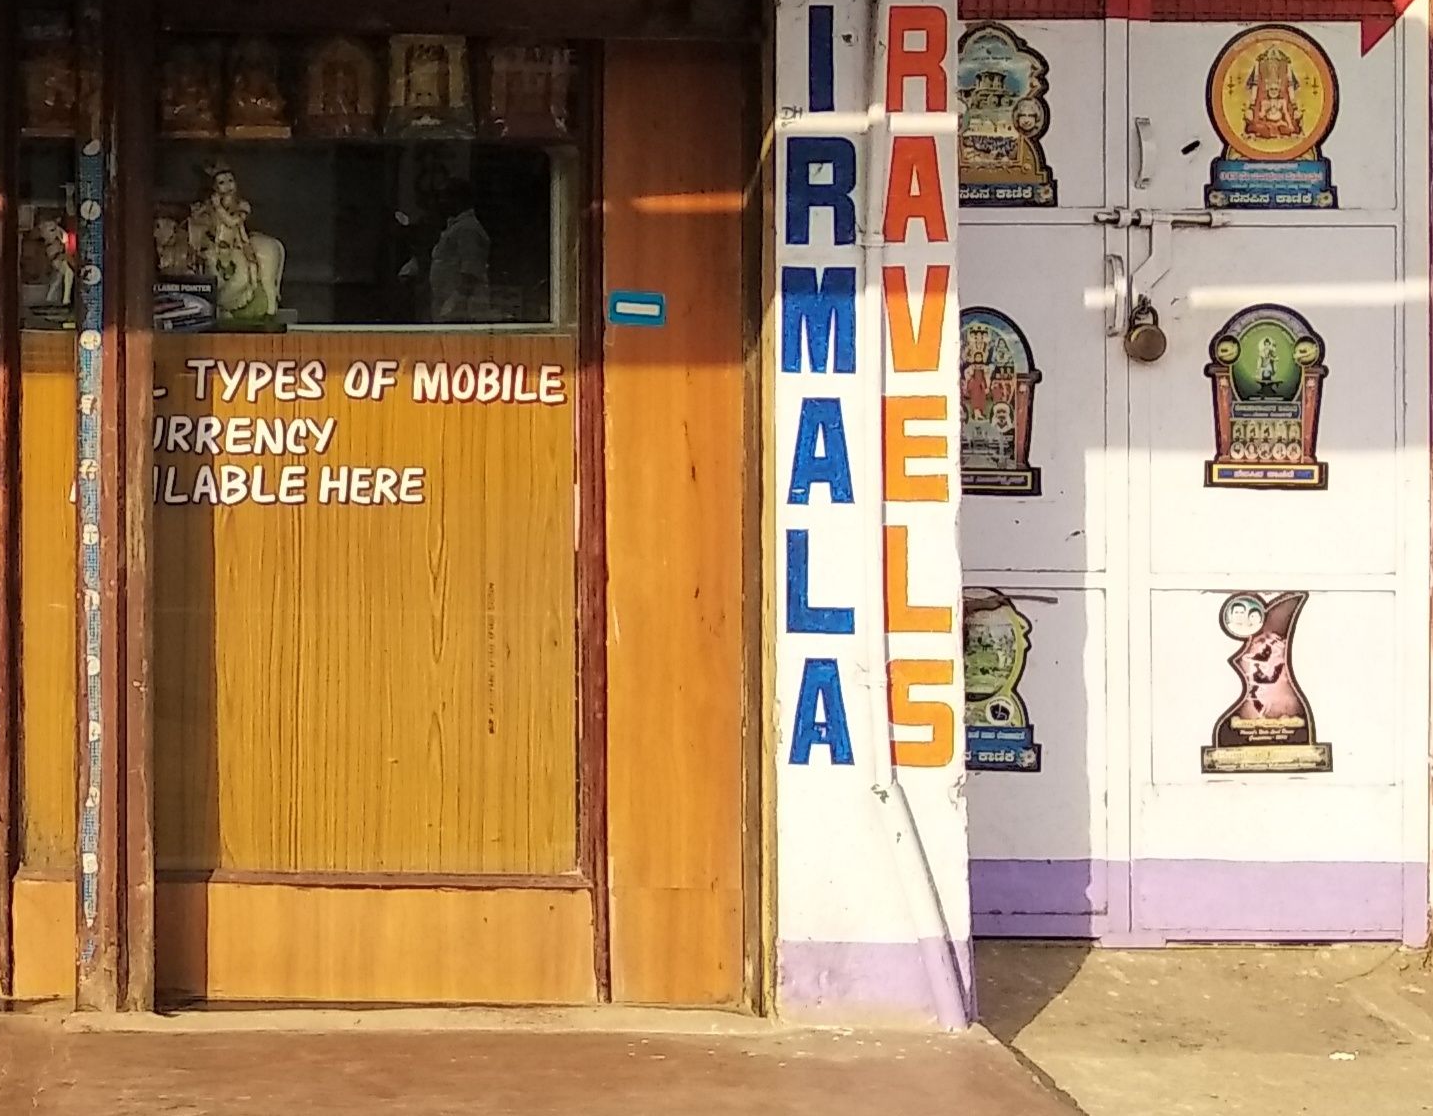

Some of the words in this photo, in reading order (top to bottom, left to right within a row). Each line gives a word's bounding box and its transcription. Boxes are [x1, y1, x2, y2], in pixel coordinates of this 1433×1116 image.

[186, 358, 325, 403] TYPES
[343, 360, 397, 401] OF
[412, 362, 566, 403] MOBILE
[319, 465, 425, 505] HERE
